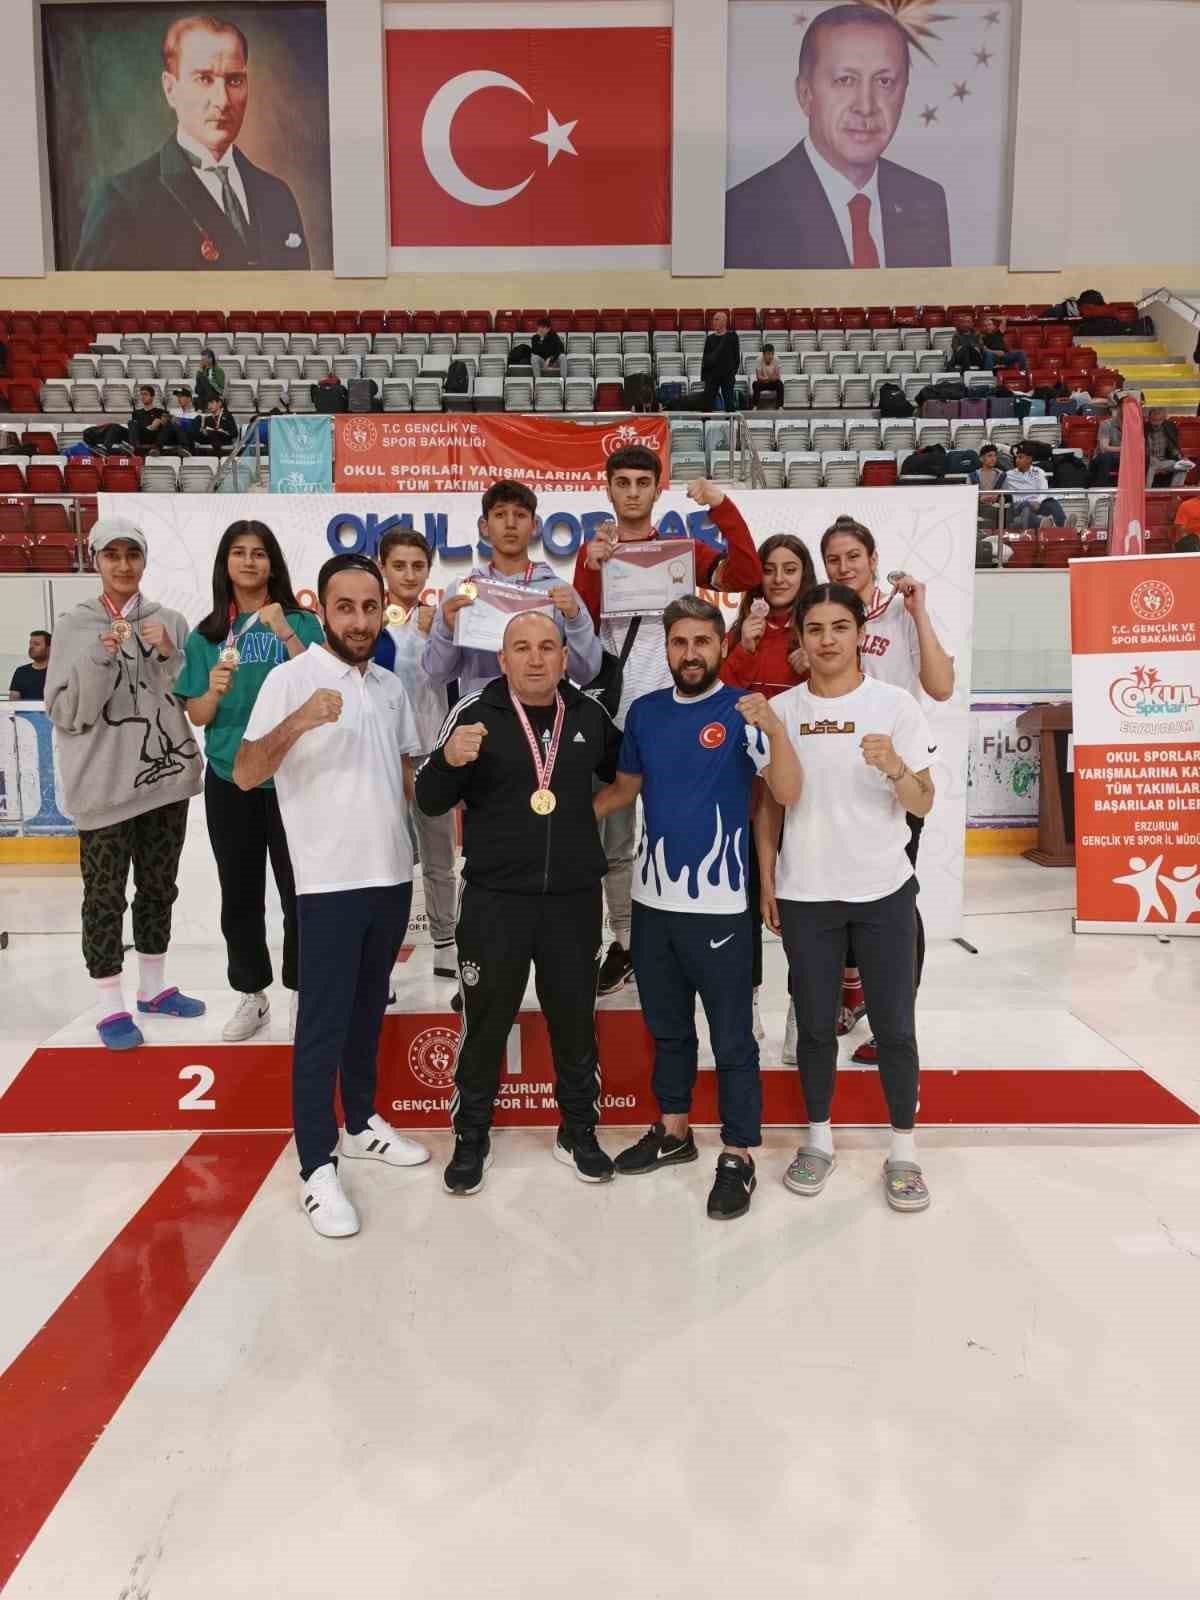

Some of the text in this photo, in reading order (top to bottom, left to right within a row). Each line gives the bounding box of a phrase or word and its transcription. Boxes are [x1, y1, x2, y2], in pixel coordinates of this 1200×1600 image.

[405, 422, 458, 435] GENÇLİK
[462, 424, 478, 433] VE
[382, 436, 486, 448] SPOR BAKANLIĞI
[343, 465, 385, 476] OKUL
[391, 464, 464, 476] SPORLARI
[469, 465, 592, 481] YARIŞMALARINA
[397, 478, 429, 491] TÜM
[1132, 622, 1178, 634] GENÇLİK
[1182, 623, 1196, 632] VE
[1111, 632, 1196, 645] SPOR BAKANLIĞI
[1106, 751, 1140, 763] OKUL
[1078, 767, 1178, 781] YARIŞMALARINA
[1105, 782, 1132, 795] TÜM
[1094, 799, 1164, 814] BAŞARILAR
[1135, 820, 1179, 832] ERZURUM
[1082, 833, 1121, 847] GENÇLİK
[1123, 836, 1137, 845] VE
[1137, 835, 1162, 845] SPOR
[1165, 832, 1174, 845] İL
[178, 1065, 216, 1110] 2
[499, 1083, 553, 1095] ZURUM
[526, 1095, 538, 1109] İL
